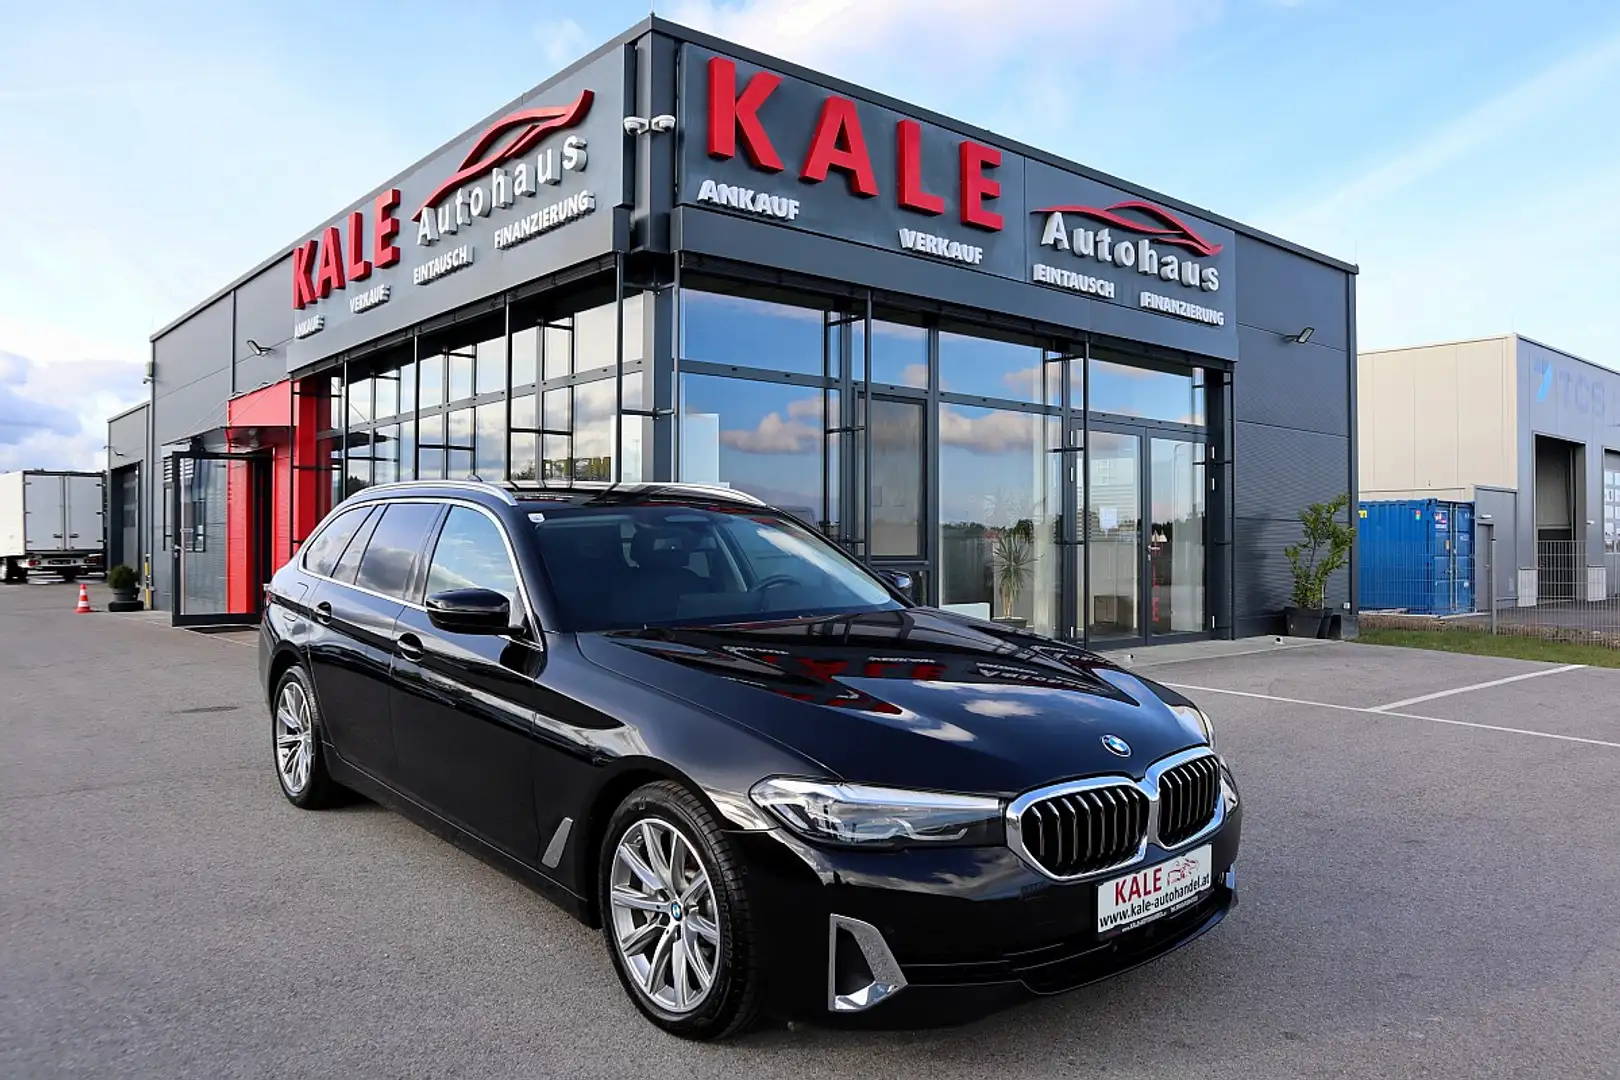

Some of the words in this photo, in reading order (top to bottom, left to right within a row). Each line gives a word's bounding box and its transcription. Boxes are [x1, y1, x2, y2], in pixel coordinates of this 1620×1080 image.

[292, 188, 401, 310] KALE
[417, 135, 588, 246] Autohaus
[708, 56, 1004, 231] KALE
[1041, 211, 1219, 292] Autohaus
[294, 314, 325, 339] ANKAUF
[350, 283, 391, 314] VERKAUF
[413, 243, 475, 285] EINTAUSCH
[494, 189, 596, 250] FINANZIERUNG
[697, 179, 799, 221] ANKAUF
[899, 228, 983, 265] VERKAUF
[1033, 263, 1115, 299] EINTAUSCH
[1140, 291, 1224, 326] FINANZIERUNG
[1100, 873, 1210, 928] www.kale-autohandel.at
[1115, 867, 1162, 906] KALE
